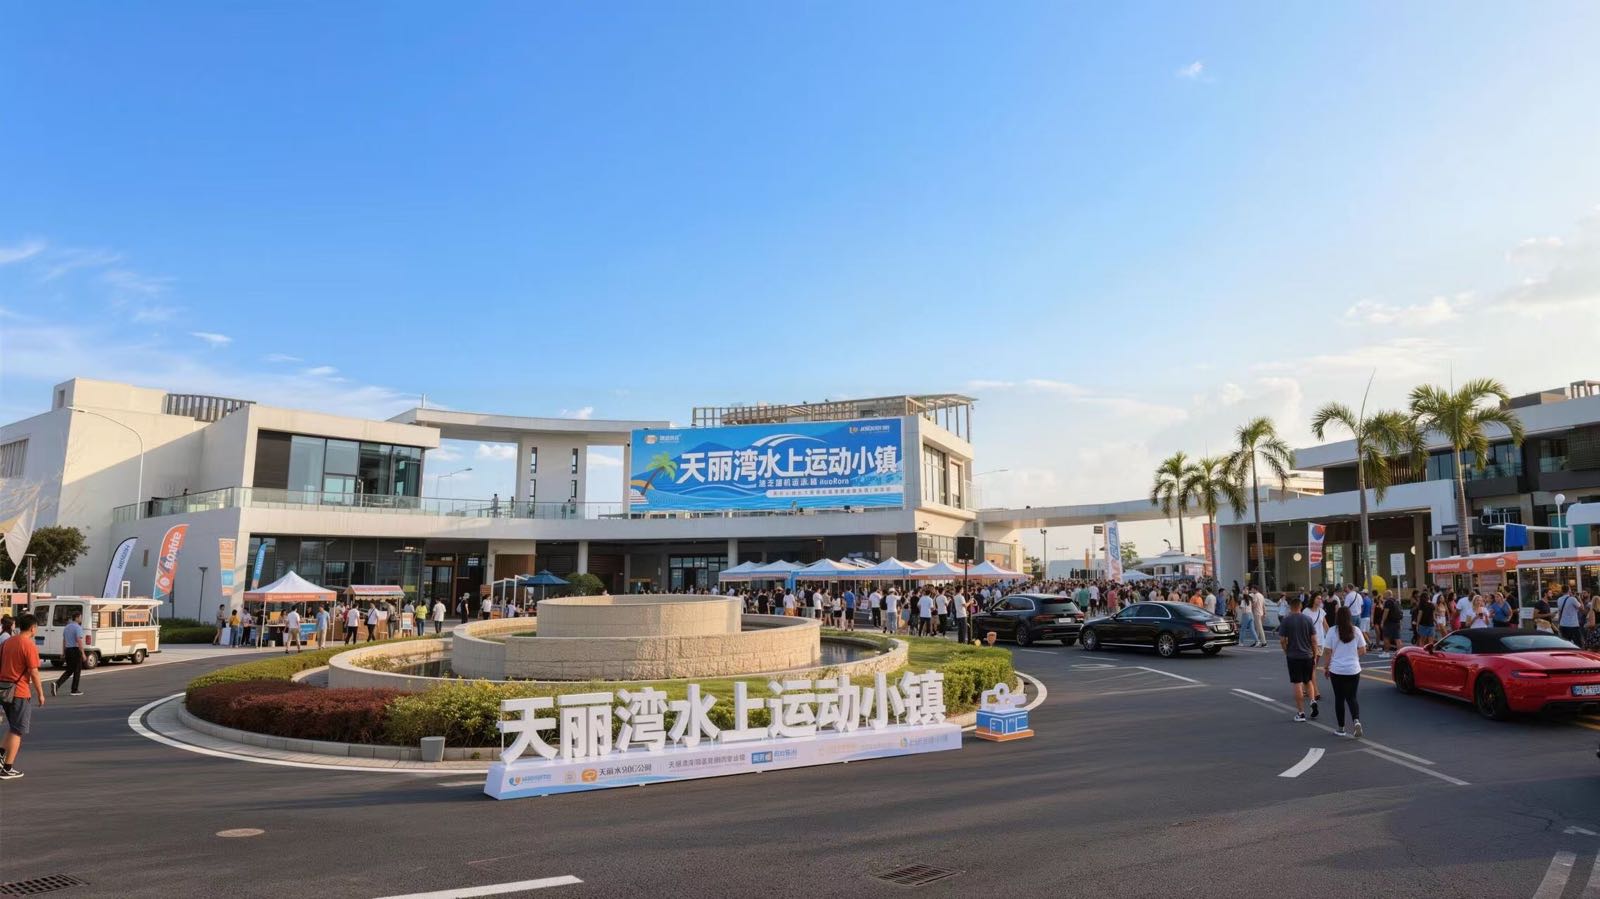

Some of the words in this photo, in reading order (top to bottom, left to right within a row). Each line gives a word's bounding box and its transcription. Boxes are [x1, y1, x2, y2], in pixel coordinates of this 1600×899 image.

[677, 446, 897, 484] 天丽湾水上运动小镇
[498, 670, 947, 765] 天丽湾水上运动小镇
